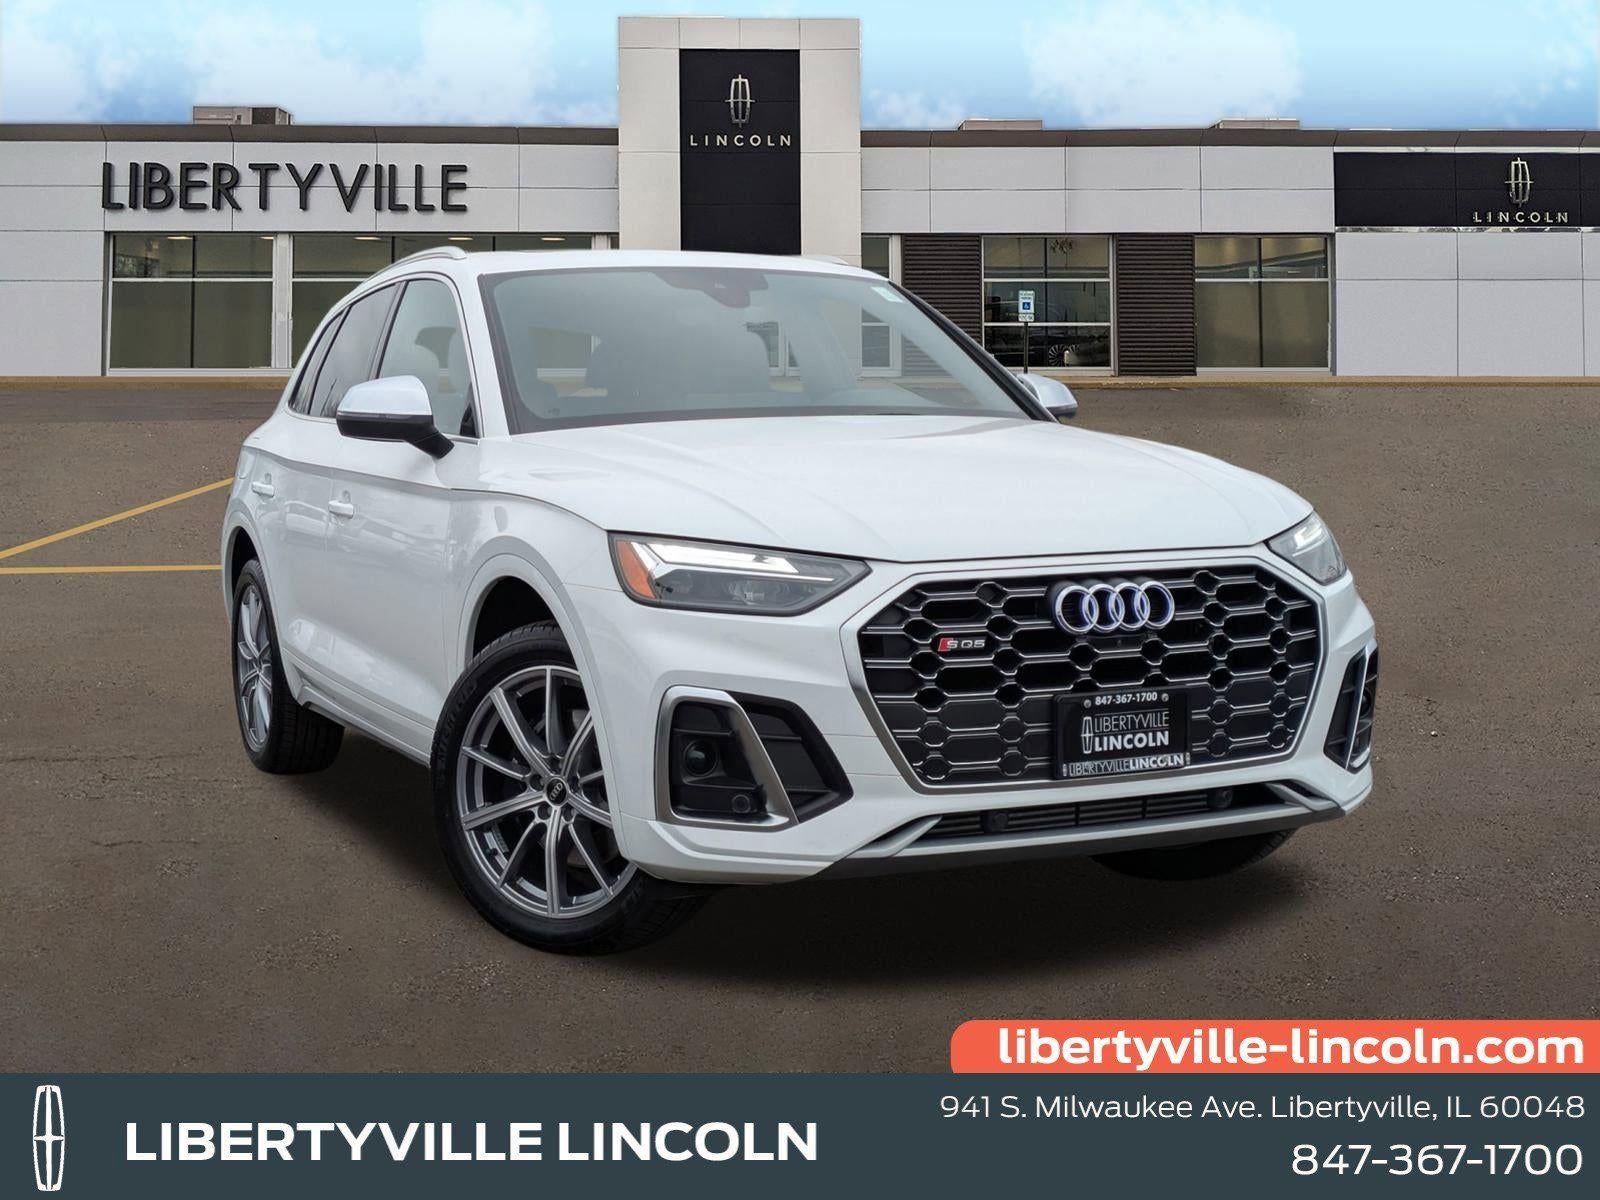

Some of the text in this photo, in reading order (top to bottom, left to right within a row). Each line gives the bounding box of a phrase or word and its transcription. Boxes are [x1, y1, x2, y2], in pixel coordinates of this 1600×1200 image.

[689, 133, 792, 147] LINCOLN
[101, 161, 468, 213] LIBERTYVILLE
[1472, 211, 1569, 224] LINCOLN
[1095, 691, 1158, 706] 847-367-1700
[1094, 711, 1170, 733] LIBERTYVILLE
[1094, 730, 1170, 753] LINCOLN
